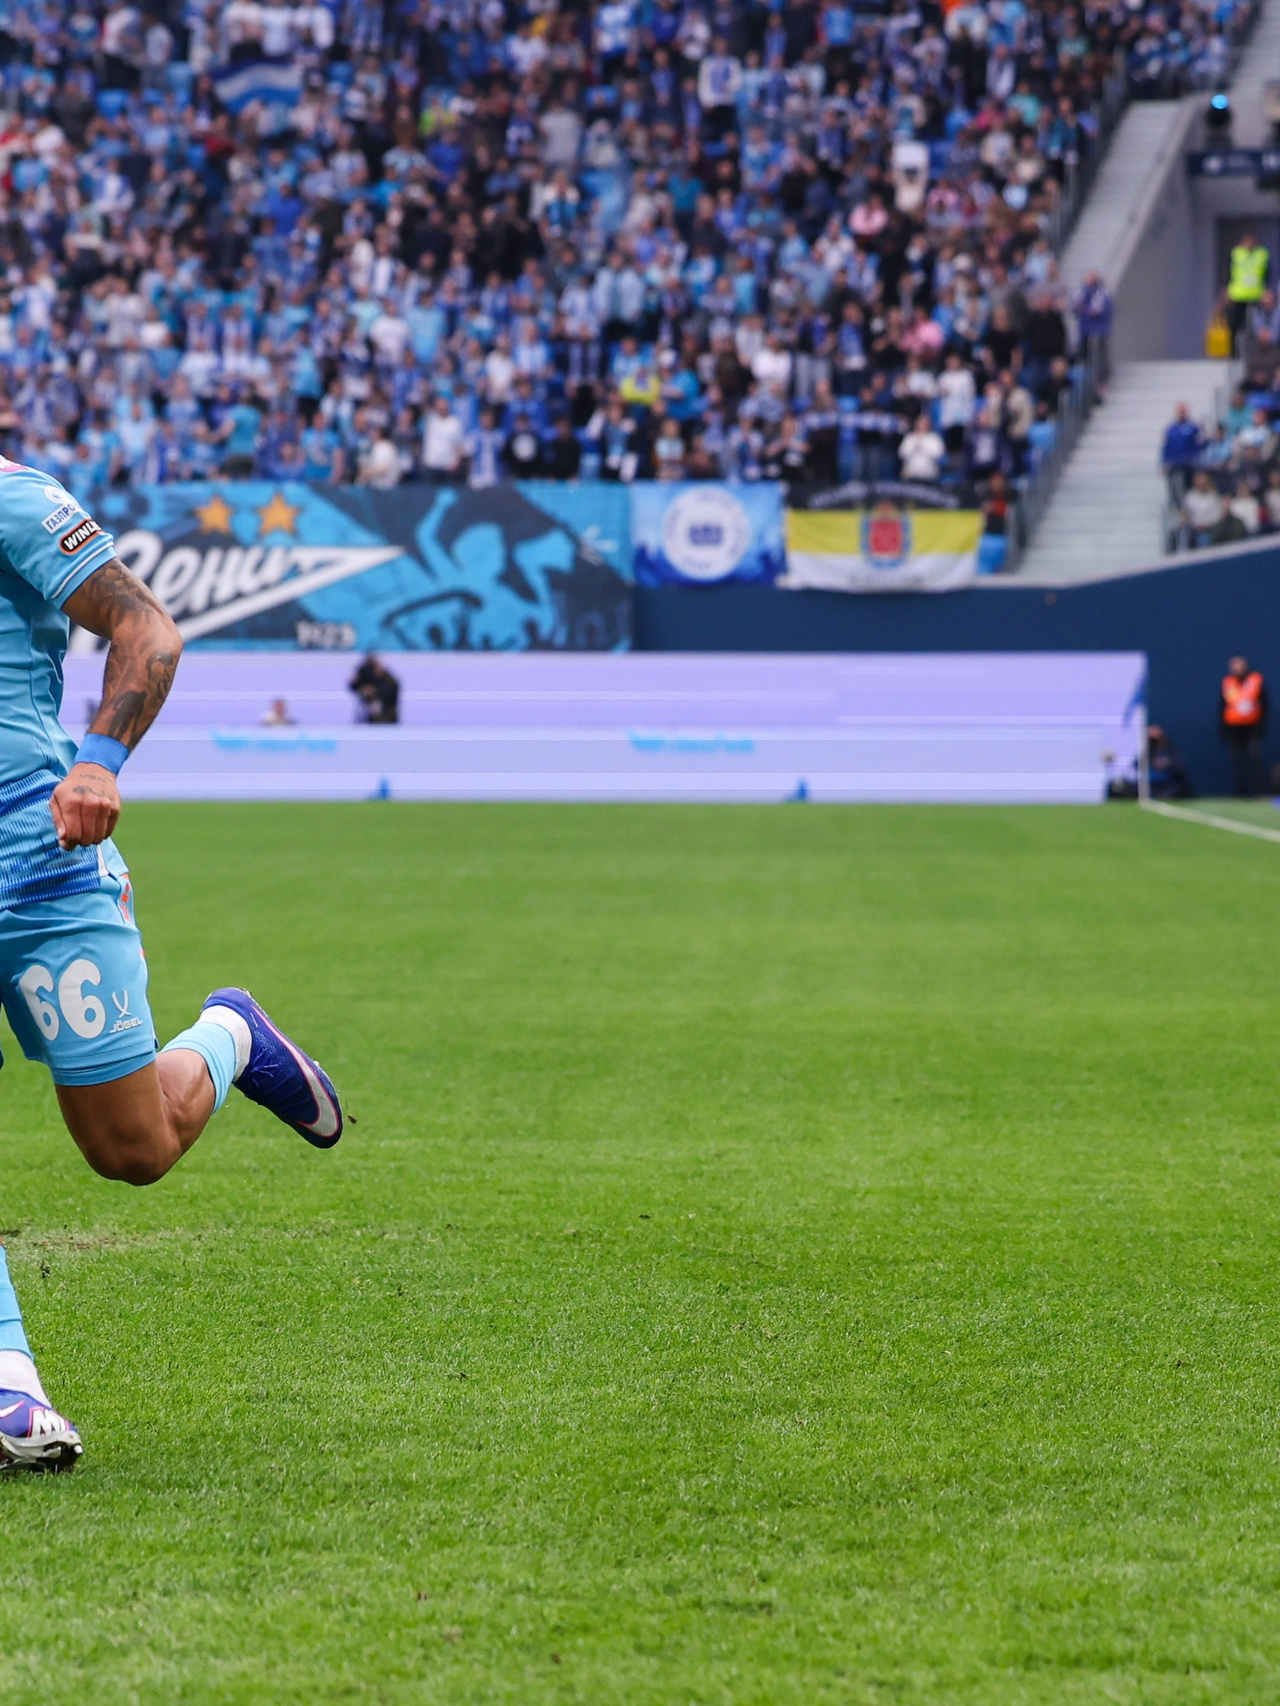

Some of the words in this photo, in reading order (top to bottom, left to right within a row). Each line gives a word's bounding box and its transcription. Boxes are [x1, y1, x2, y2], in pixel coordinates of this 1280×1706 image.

[45, 503, 77, 530] ГАЗПРО
[19, 958, 106, 1042] 66
[109, 1016, 144, 1034] JÖGEL
